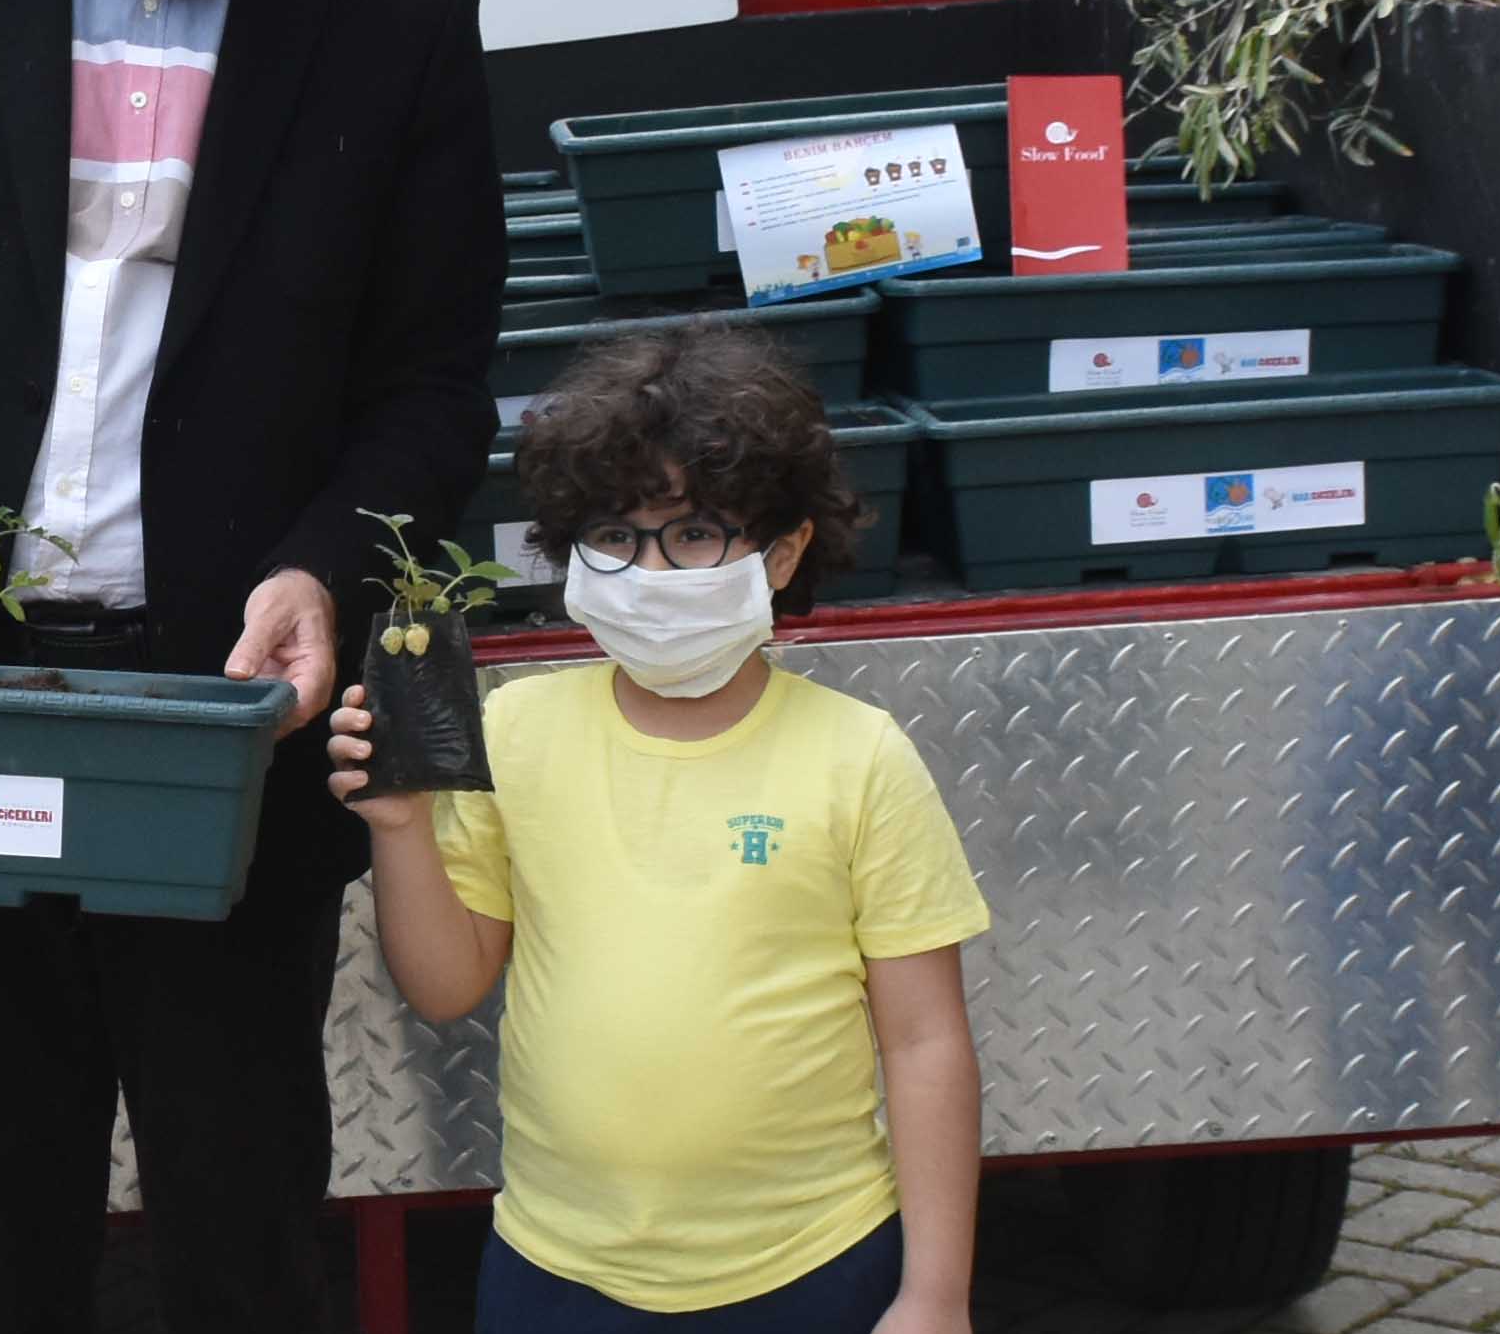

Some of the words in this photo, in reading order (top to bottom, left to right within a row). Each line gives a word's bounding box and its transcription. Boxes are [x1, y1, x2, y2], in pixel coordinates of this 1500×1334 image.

[1020, 146, 1060, 162] Slow
[1064, 145, 1105, 162] Food
[742, 830, 769, 865] H
